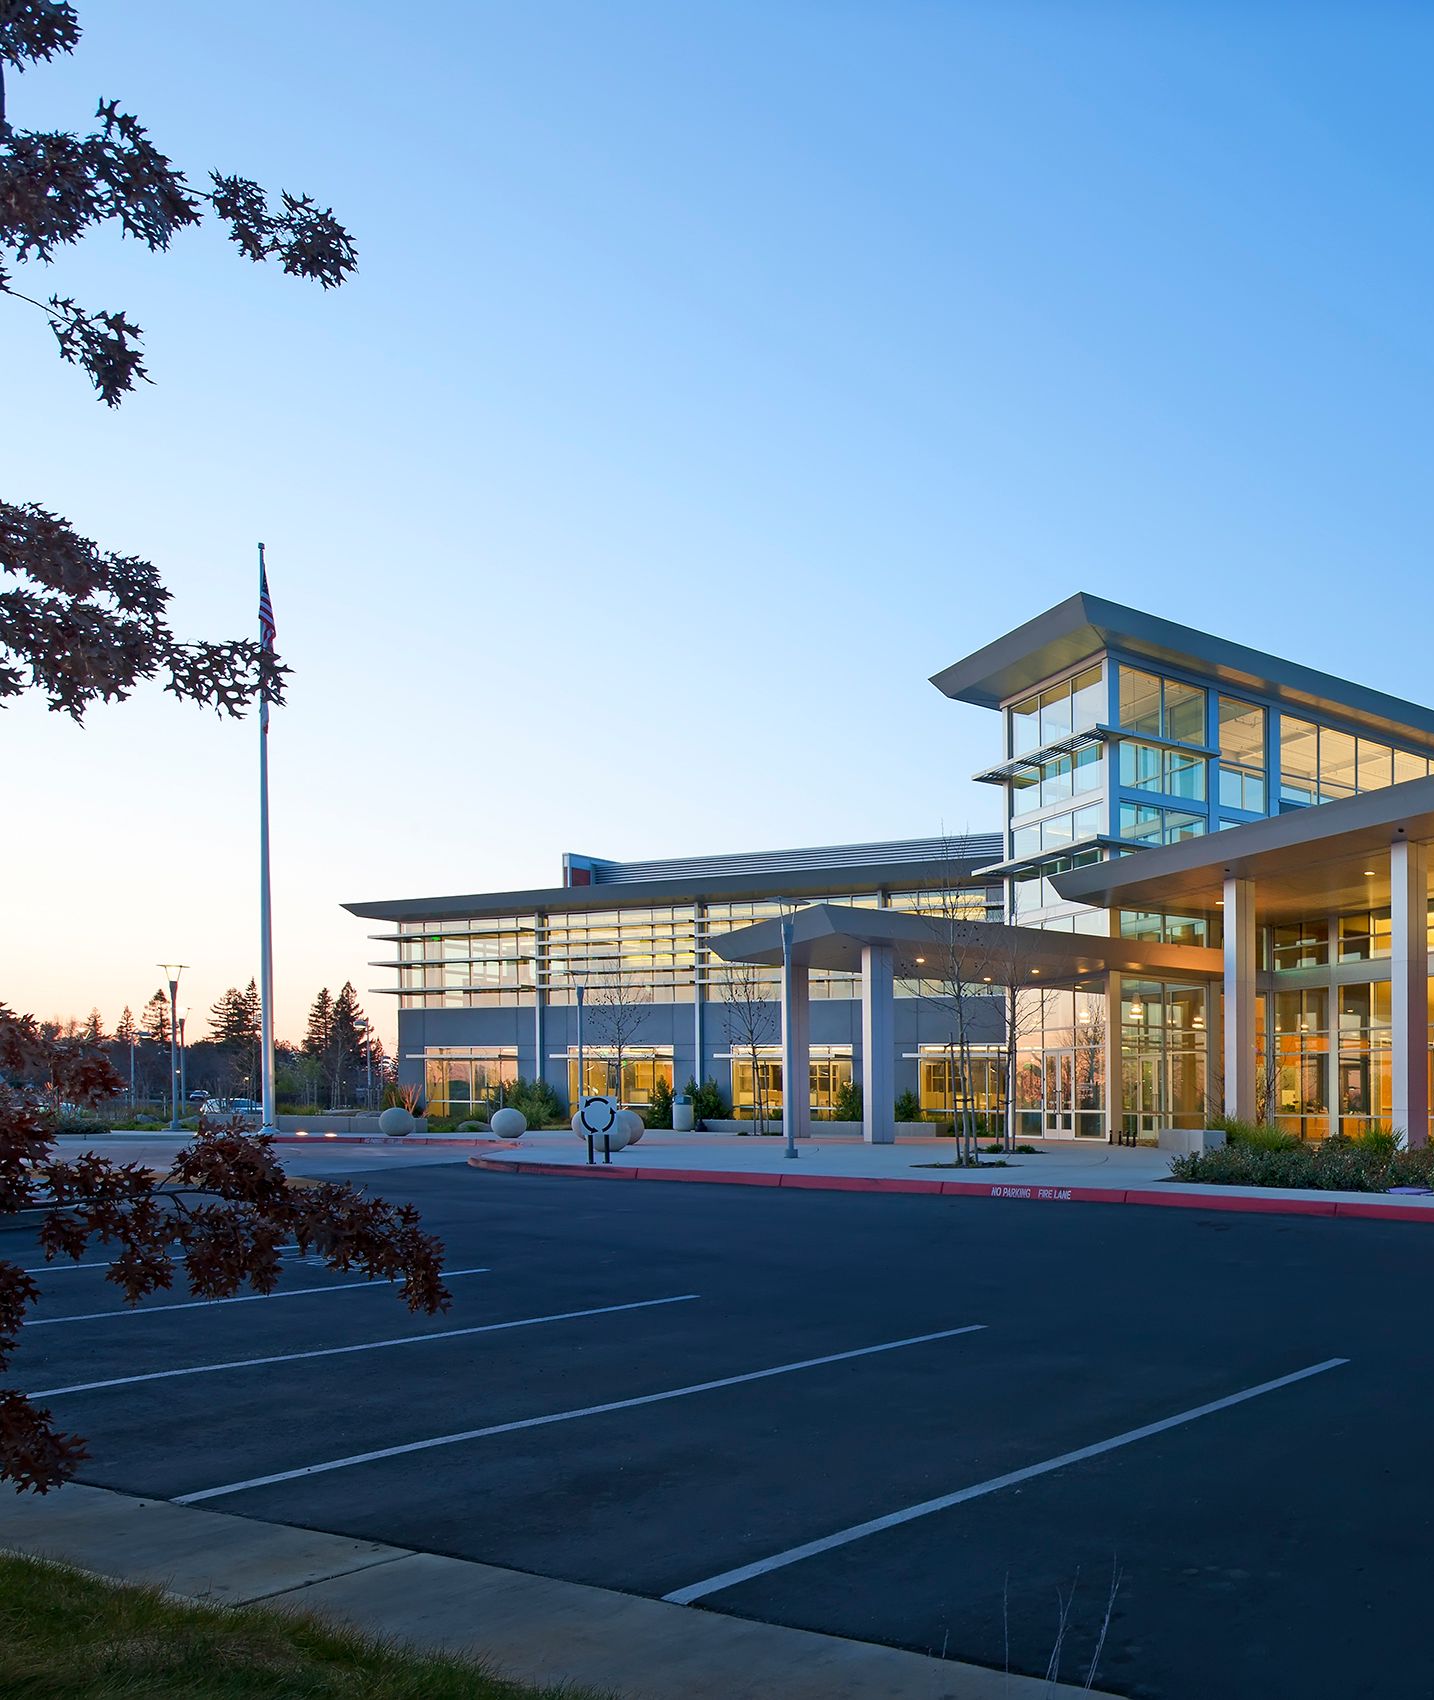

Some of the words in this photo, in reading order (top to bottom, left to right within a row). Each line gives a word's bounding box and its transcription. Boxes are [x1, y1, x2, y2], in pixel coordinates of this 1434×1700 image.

[991, 1186, 1002, 1197] NO
[1002, 1187, 1031, 1199] PARKING
[1038, 1189, 1053, 1199] FIRE
[1053, 1190, 1072, 1200] LANE
